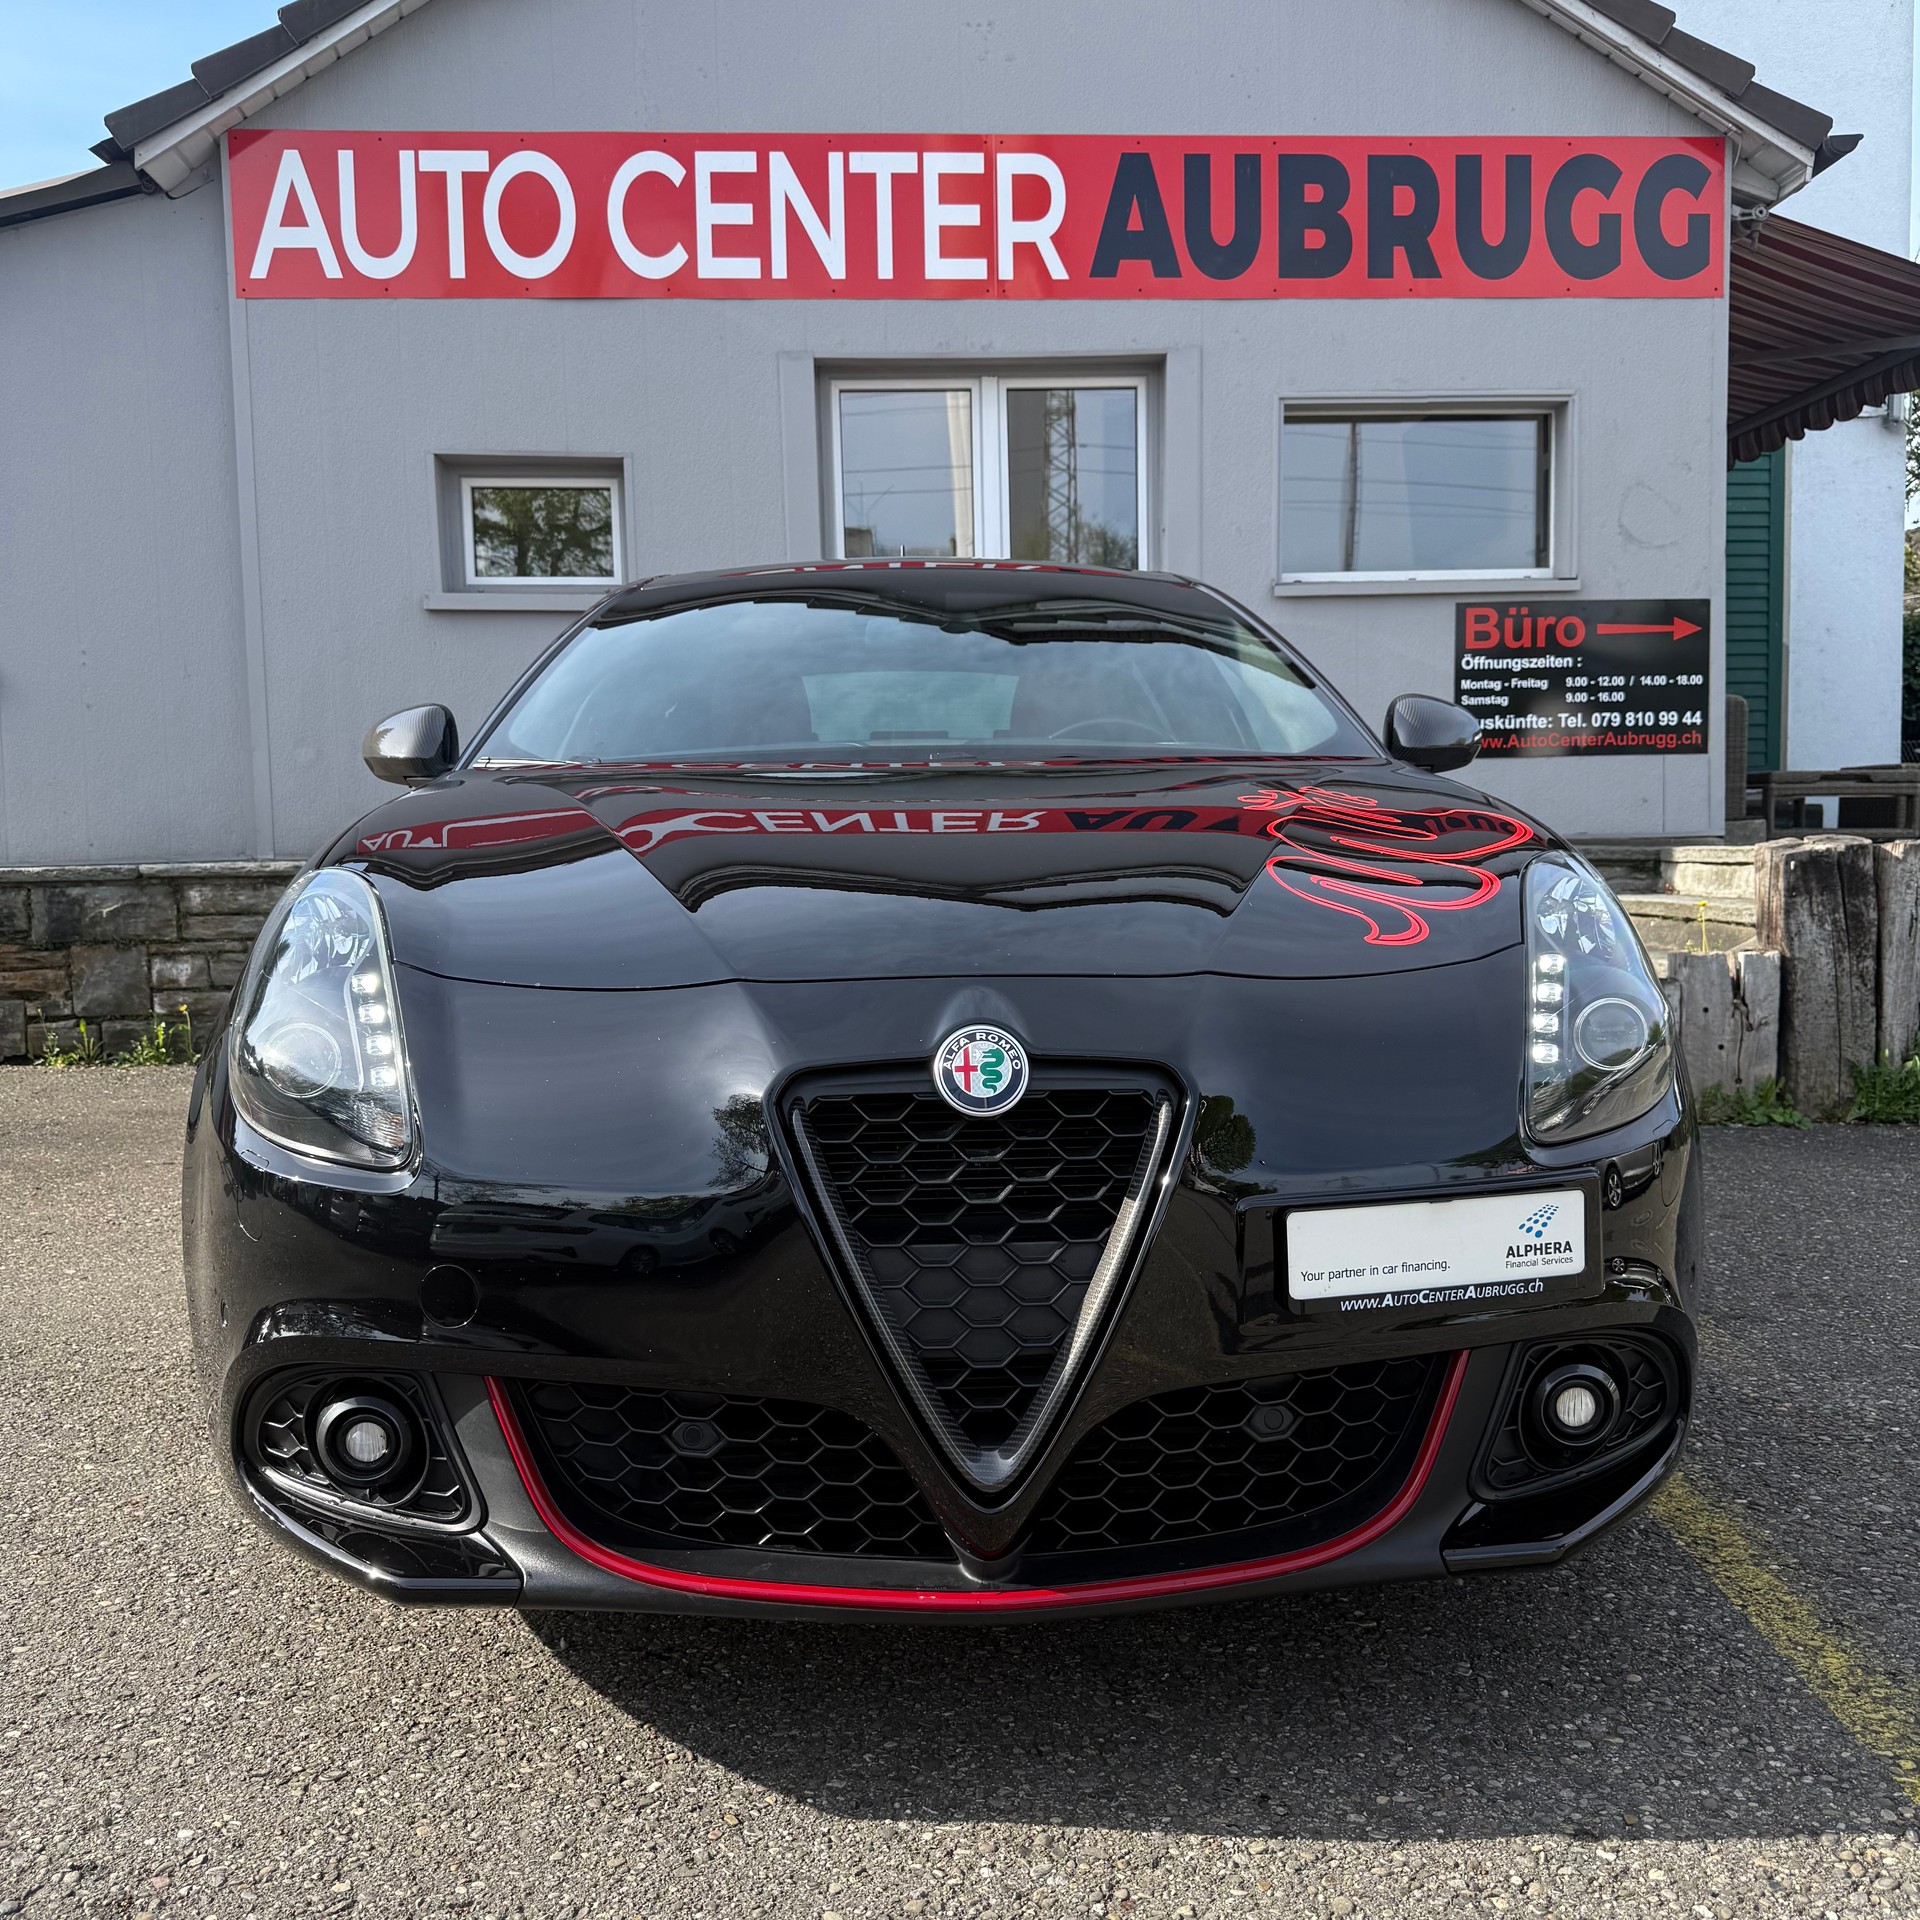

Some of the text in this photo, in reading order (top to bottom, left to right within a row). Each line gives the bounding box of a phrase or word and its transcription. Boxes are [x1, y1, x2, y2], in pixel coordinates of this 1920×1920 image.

[250, 149, 1712, 281] AUTO CENTER AUBRUGG
[1465, 607, 1586, 650] Büro
[1461, 653, 1574, 672] Öffnungszeiten
[1460, 679, 1502, 691] Montag
[1511, 677, 1549, 691] Freitag
[1565, 676, 1588, 688] 9.00
[1597, 675, 1626, 687] 12.00
[1639, 674, 1667, 686] 14.00
[1675, 674, 1704, 686] 18.00
[1460, 695, 1510, 707] Samstag
[1565, 692, 1588, 703] 9.00
[1597, 691, 1626, 703] 16.00
[1477, 710, 1703, 730] uskünfte: Tel. 079 810 99 44
[1480, 730, 1702, 749] ww.AutoCenterAubrugg.ch
[943, 1032, 1021, 1071] ALFA ROMEO
[1505, 1240, 1573, 1259] ALPHERA
[1300, 1259, 1451, 1282] Your partner in car financing.
[1505, 1255, 1574, 1269] Financial Services
